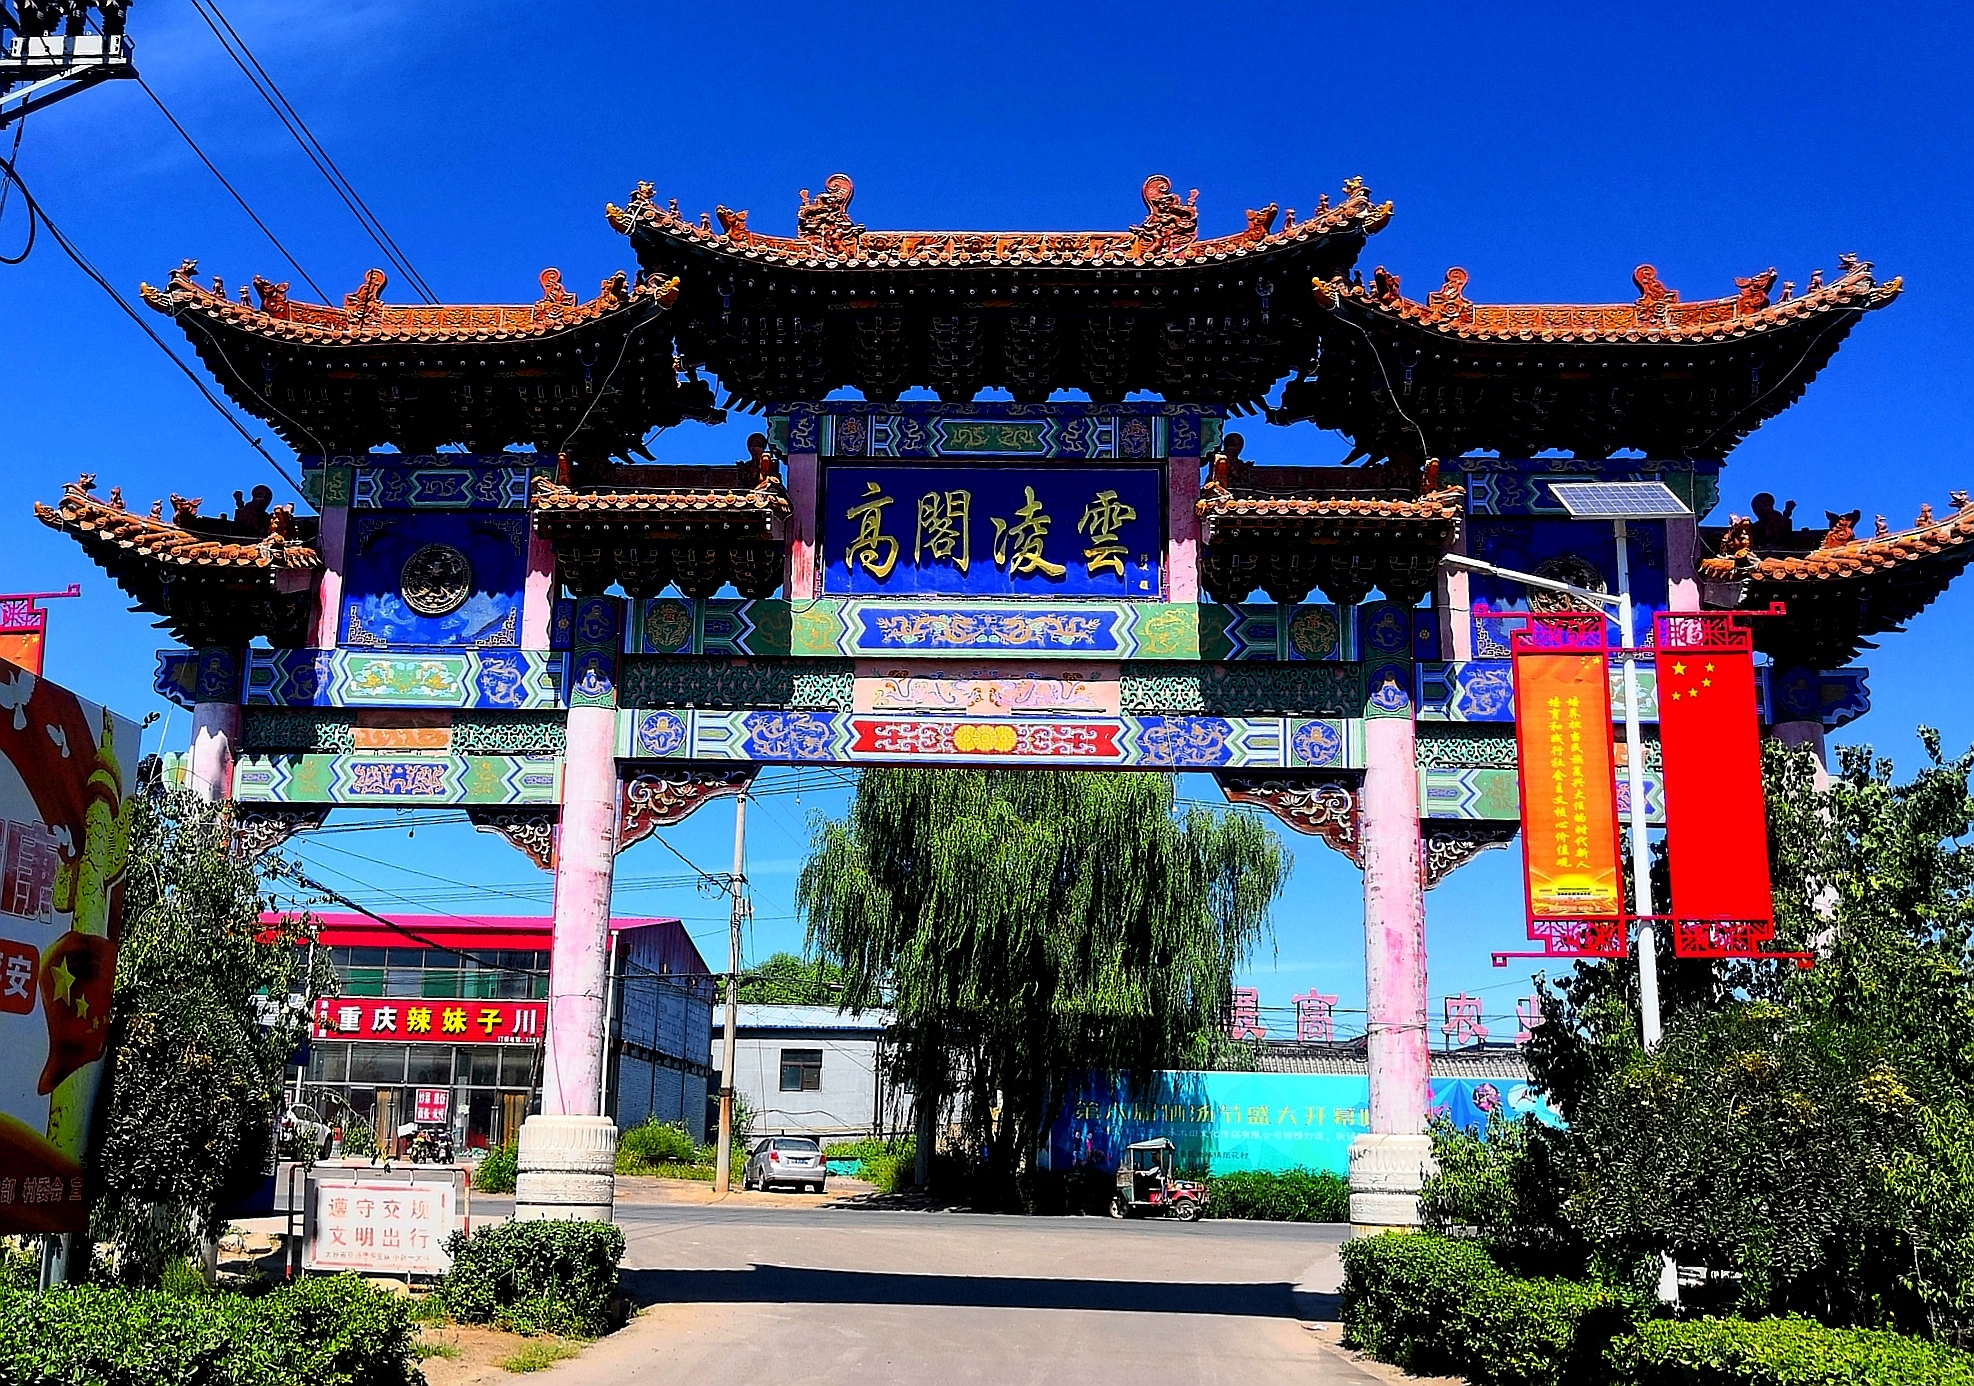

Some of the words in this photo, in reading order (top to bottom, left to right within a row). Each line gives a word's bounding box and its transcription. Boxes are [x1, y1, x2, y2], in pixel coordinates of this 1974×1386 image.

[0, 819, 58, 924] 康
[0, 952, 32, 999] 安
[338, 1006, 537, 1034] 重庆辣妹子川
[22, 1177, 64, 1203] 村委会
[328, 1197, 430, 1220] 遵守交规
[329, 1225, 430, 1249] 文明出行
